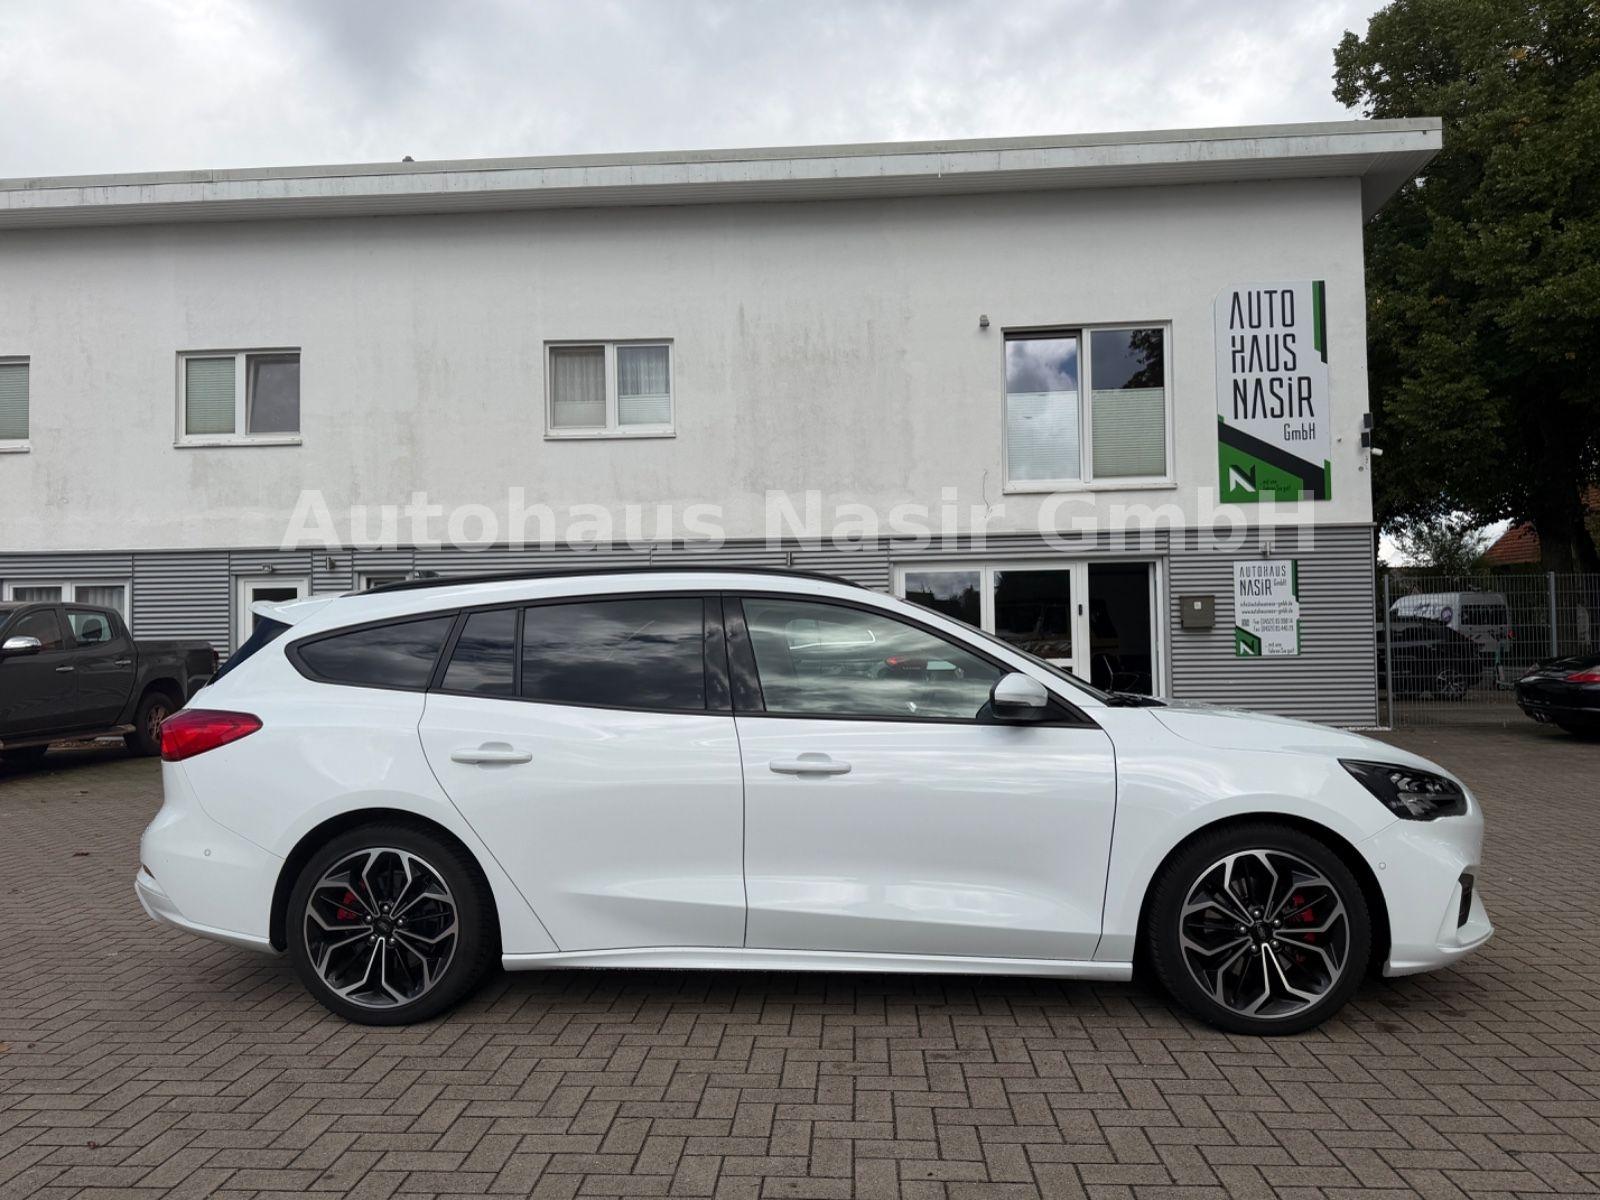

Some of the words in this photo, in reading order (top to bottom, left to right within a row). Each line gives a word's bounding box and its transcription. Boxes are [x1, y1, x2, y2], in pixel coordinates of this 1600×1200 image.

[1229, 289, 1295, 330] AUTO
[1231, 333, 1297, 374] HAUS
[1283, 422, 1316, 441] GmbH
[1239, 565, 1286, 578] AUTOHAUS
